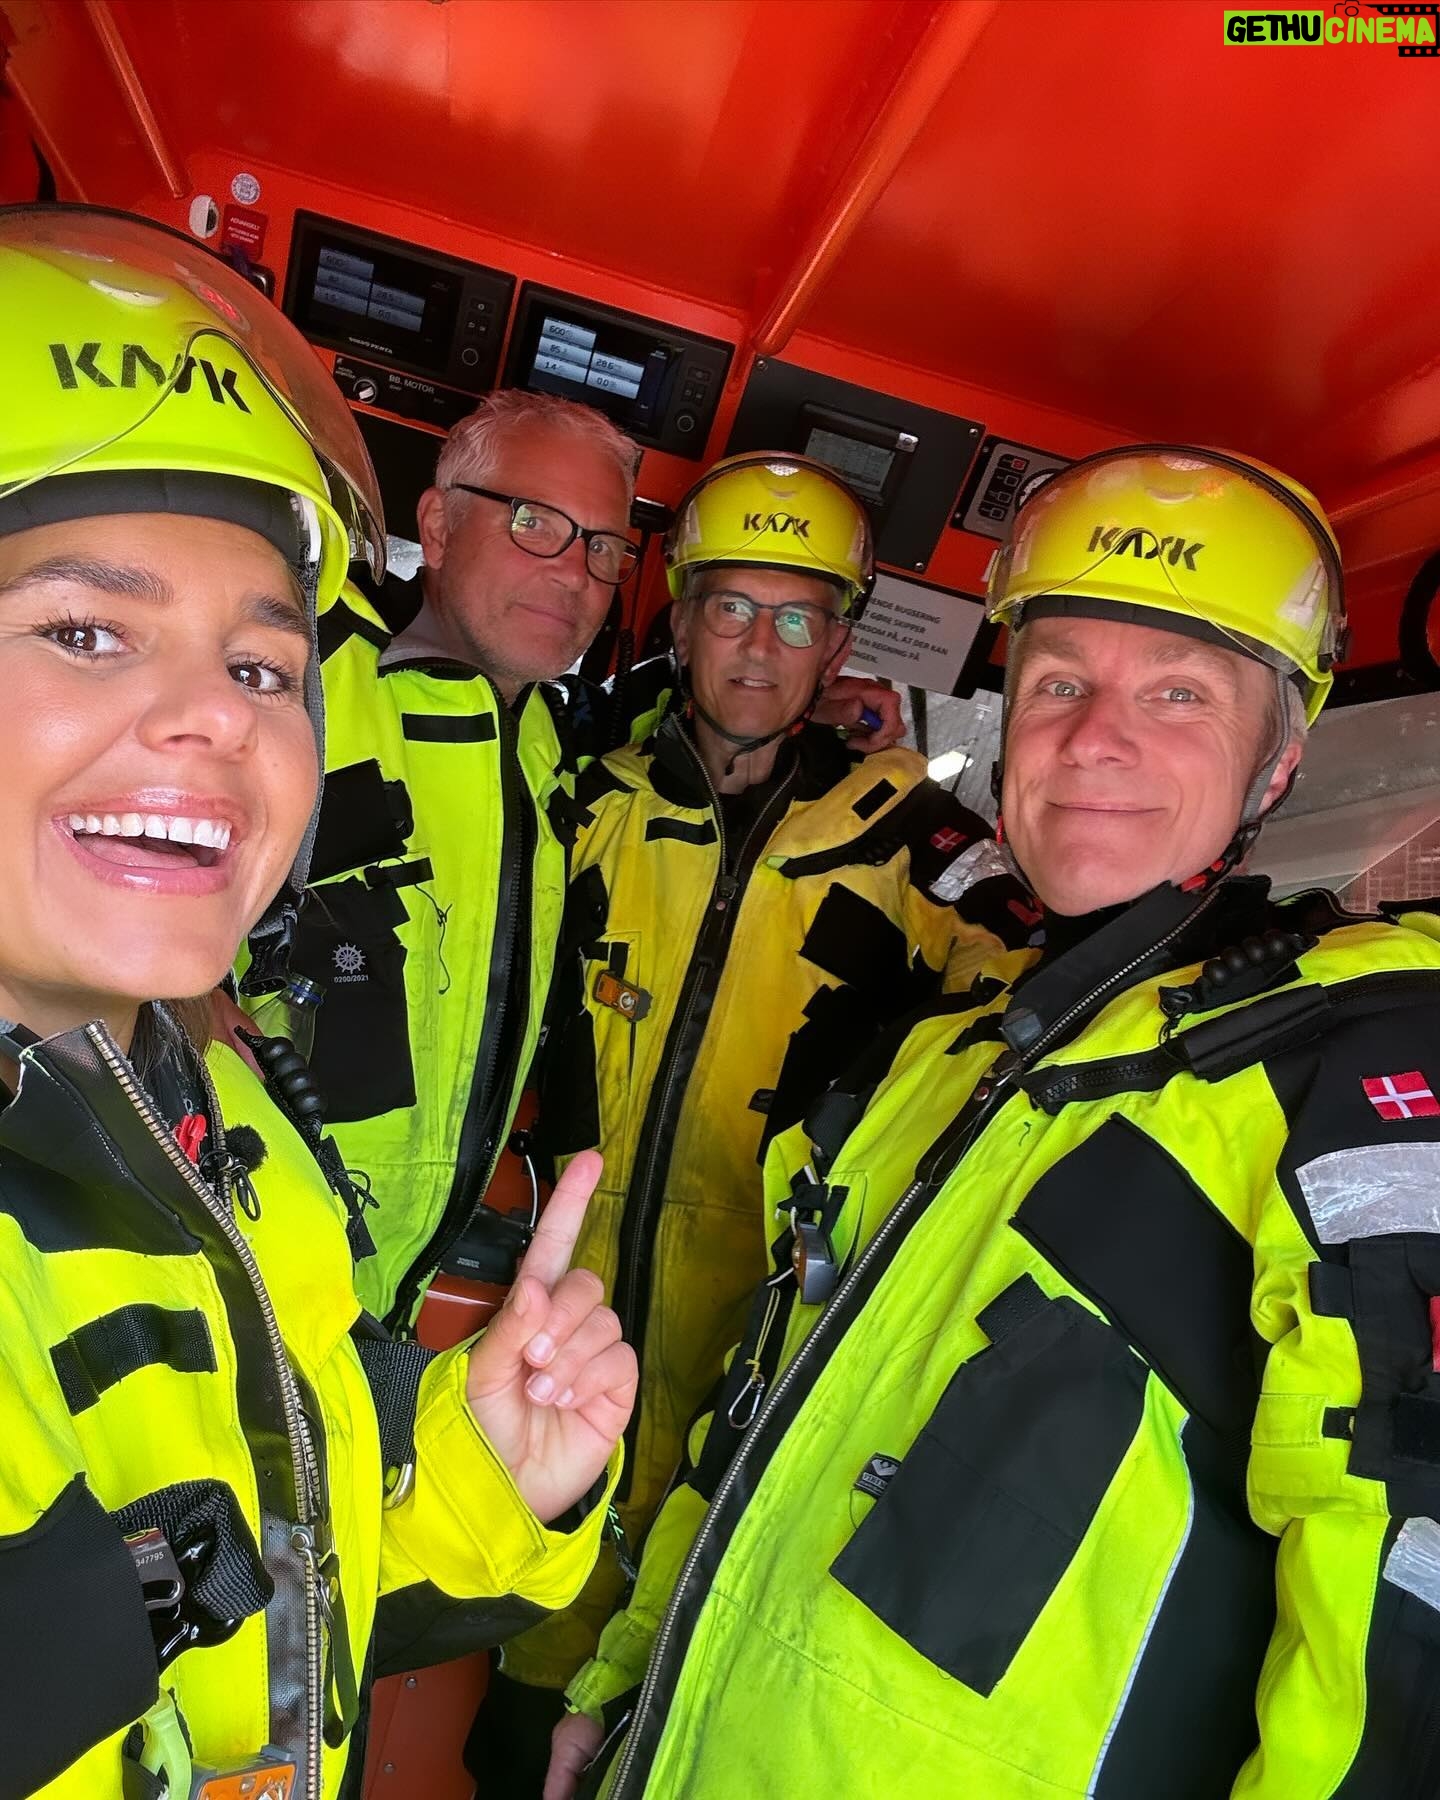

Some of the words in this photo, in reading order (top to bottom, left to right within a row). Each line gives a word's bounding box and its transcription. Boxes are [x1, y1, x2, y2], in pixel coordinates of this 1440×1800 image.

[404, 379, 435, 395] MOTOR
[894, 604, 941, 624] BUGSERING
[893, 619, 926, 634] SKIPPER
[871, 641, 908, 657] REGNING
[912, 639, 930, 649] DER
[930, 645, 949, 656] KAN
[334, 974, 369, 984] 0200/2021
